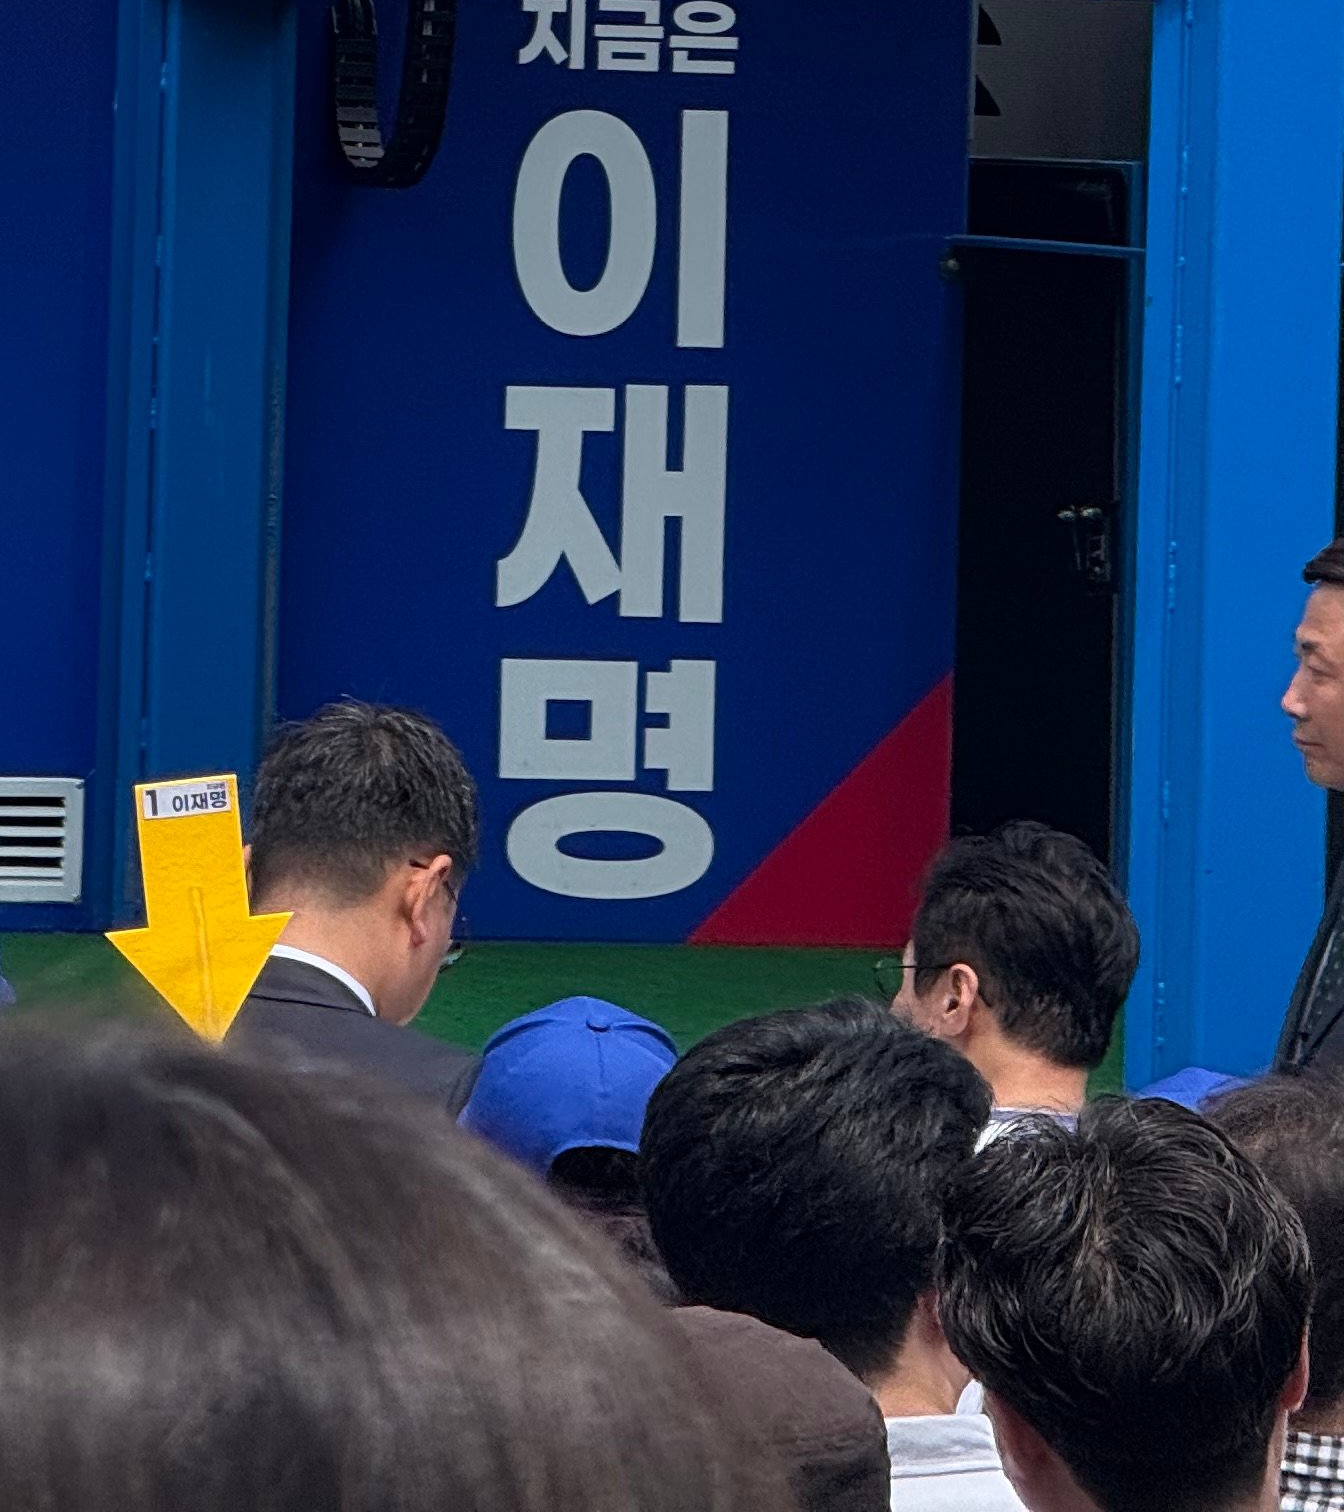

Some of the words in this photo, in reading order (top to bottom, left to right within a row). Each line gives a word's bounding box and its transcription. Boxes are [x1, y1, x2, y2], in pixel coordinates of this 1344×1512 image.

[495, 108, 729, 900] 이재명
[145, 789, 158, 817] 1
[172, 790, 227, 812] 이재명
